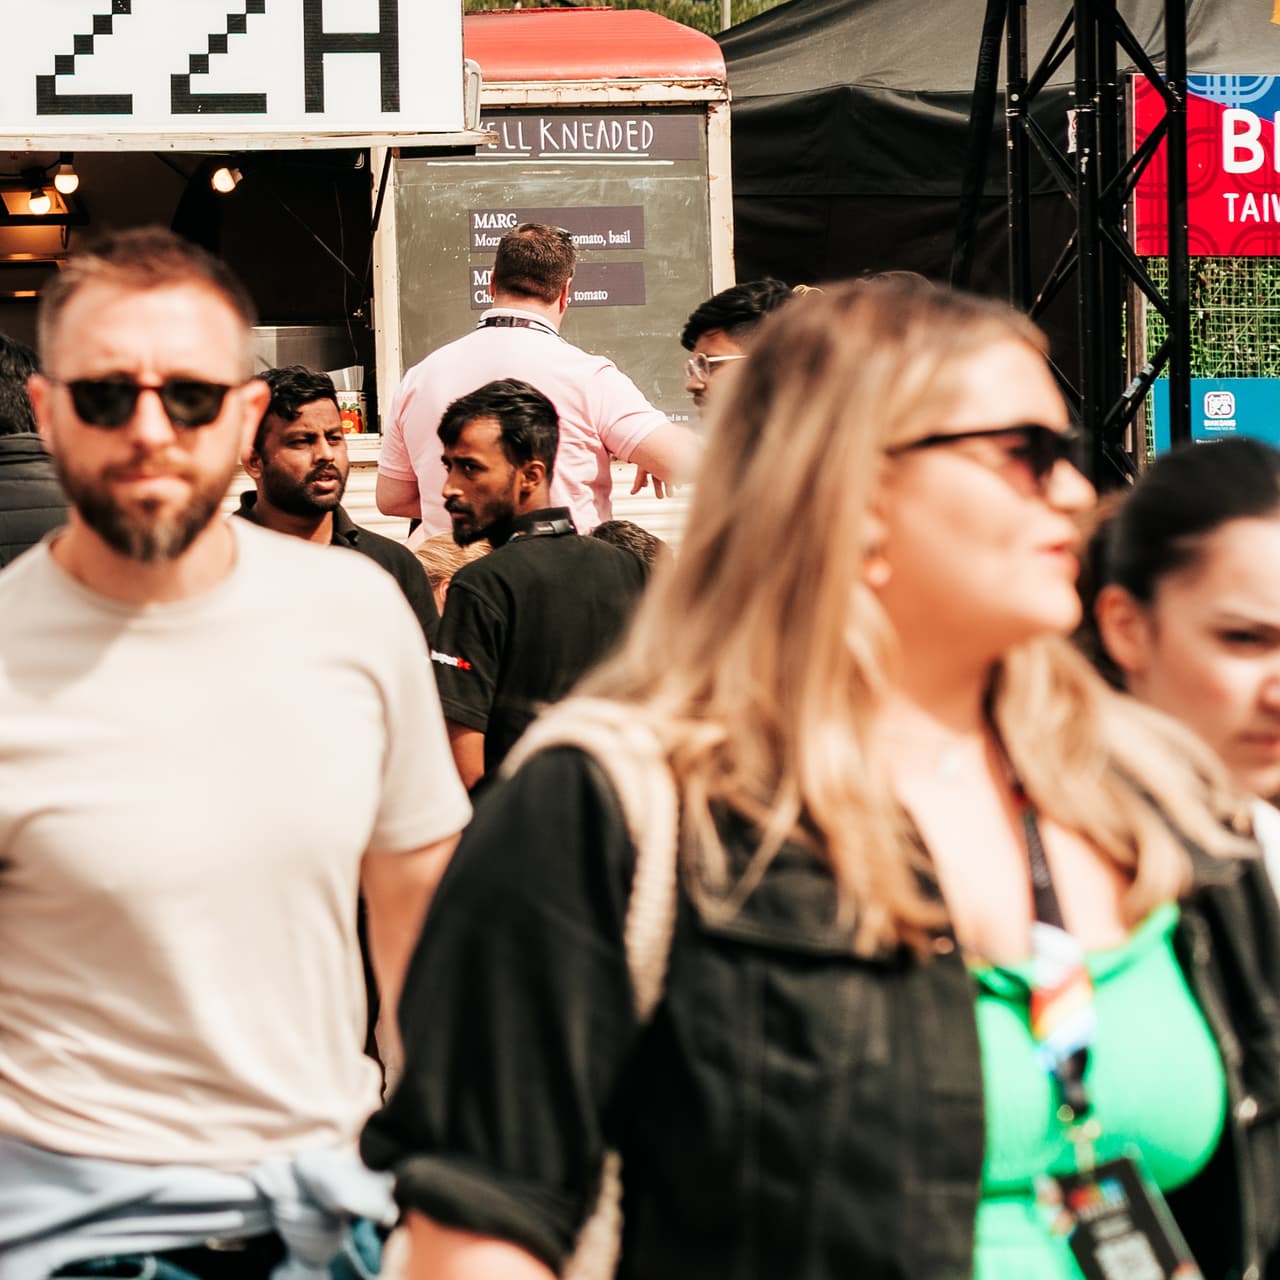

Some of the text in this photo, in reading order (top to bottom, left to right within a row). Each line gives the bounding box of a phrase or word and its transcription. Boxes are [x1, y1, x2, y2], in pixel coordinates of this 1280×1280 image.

[479, 118, 654, 151] ELL KNEADED
[1222, 108, 1280, 174] B
[474, 213, 517, 229] MARG
[570, 234, 607, 247] omato,
[609, 229, 631, 243] basil
[574, 290, 609, 301] tomato
